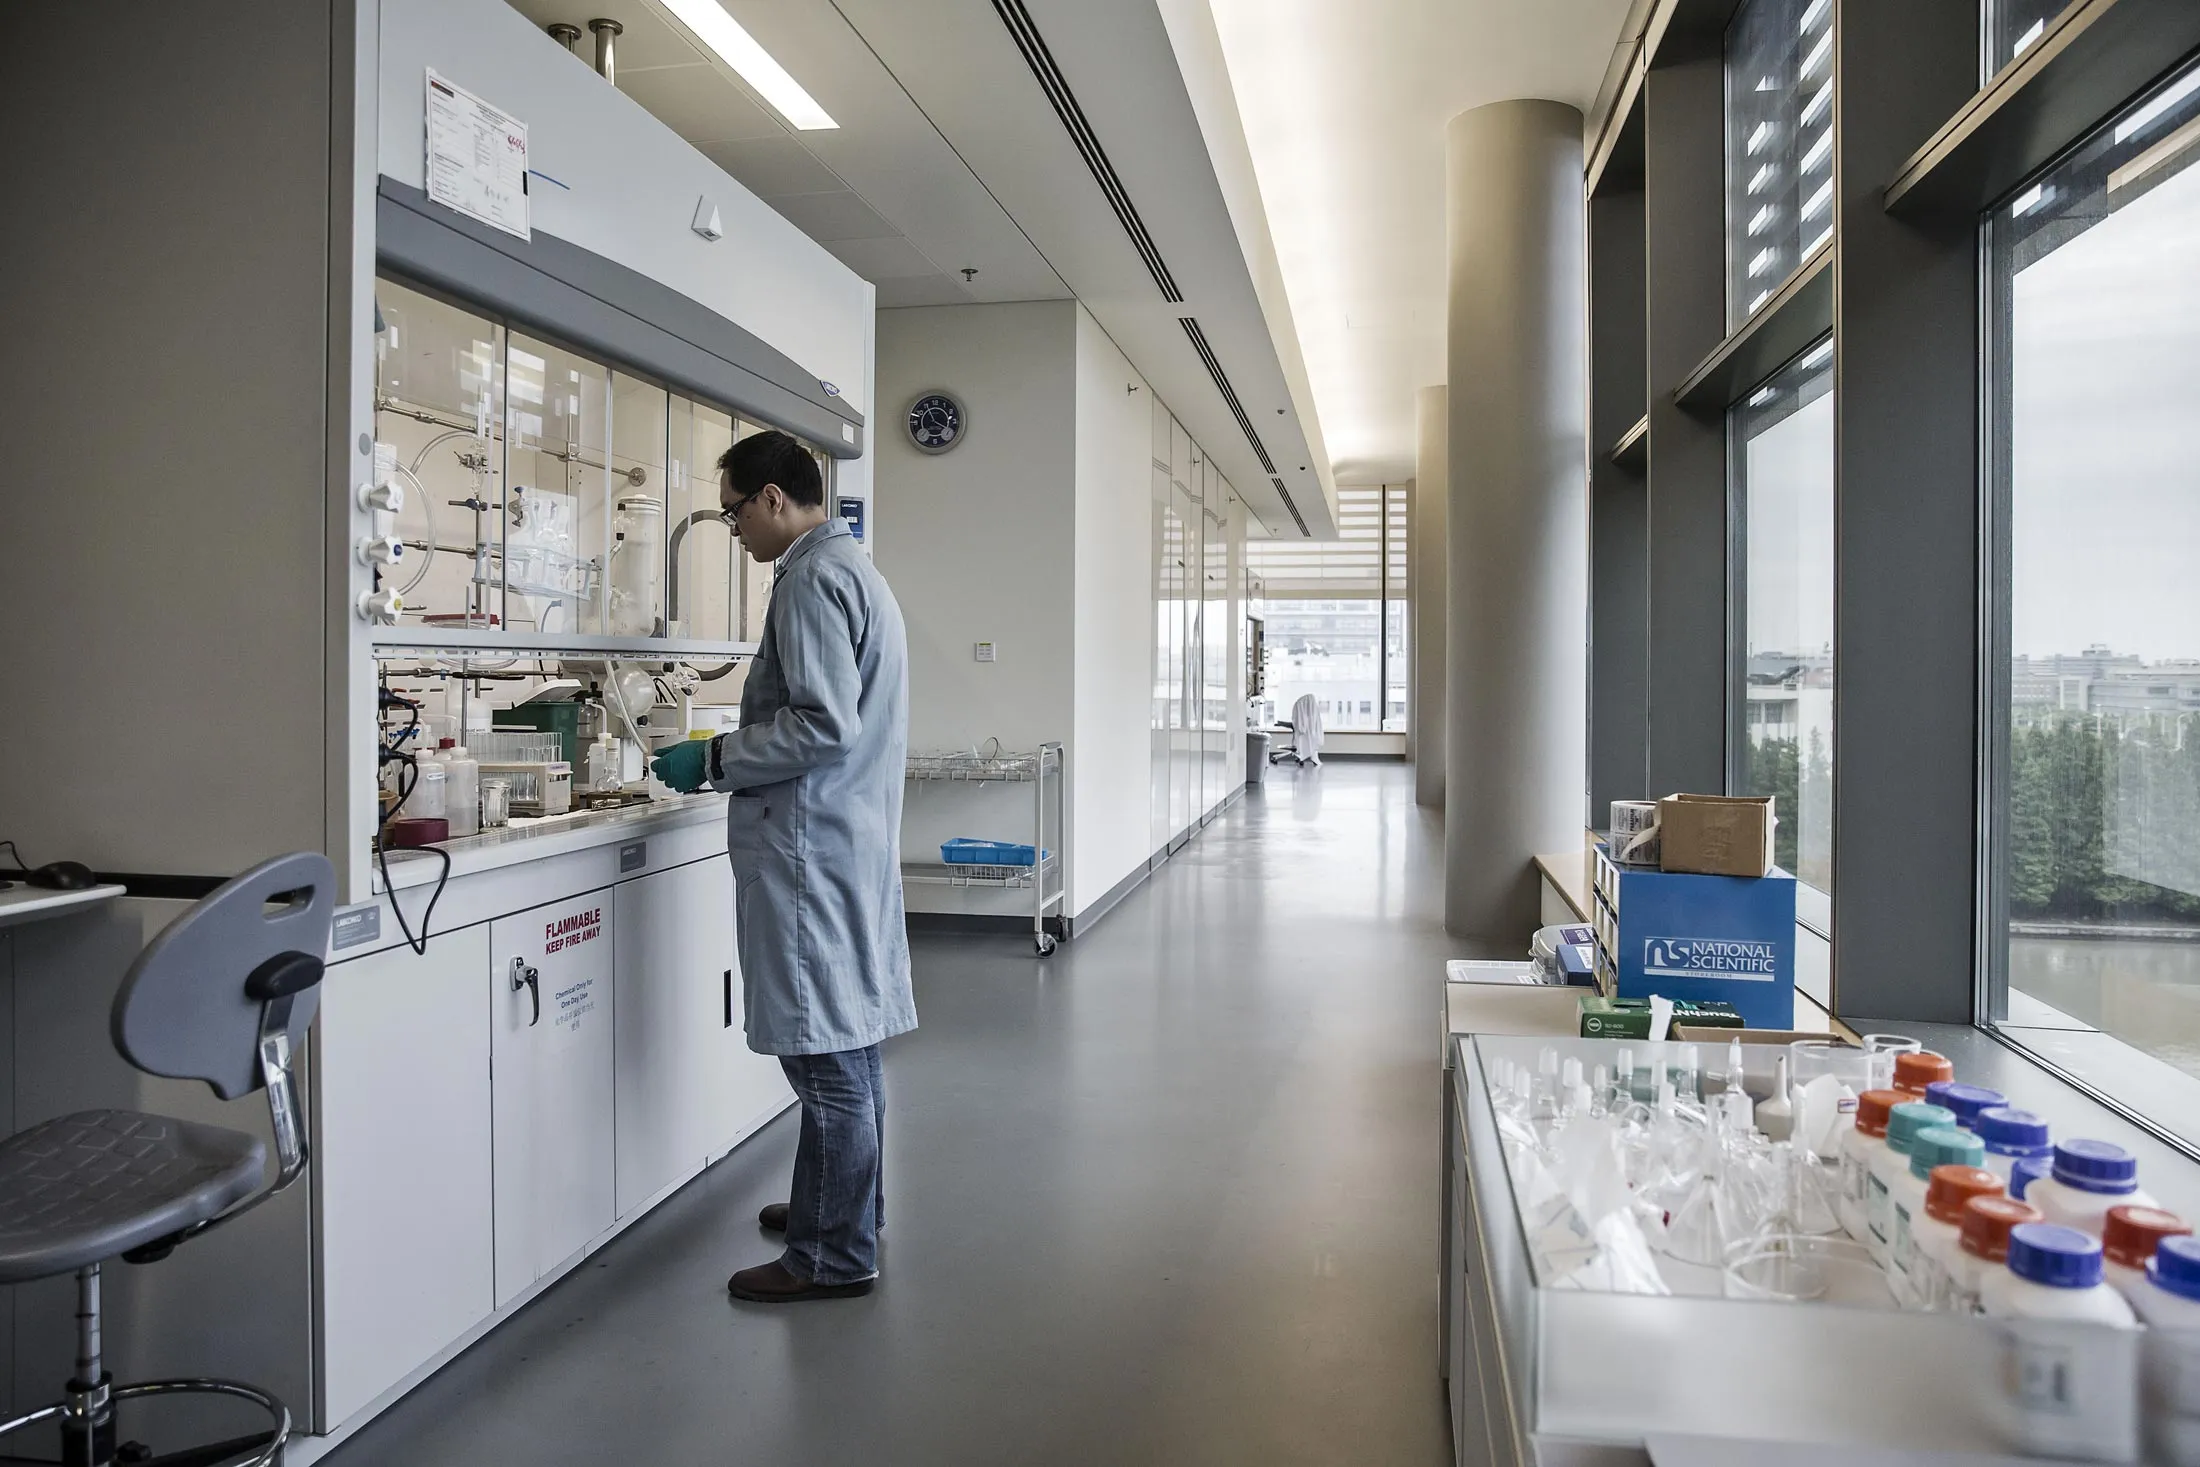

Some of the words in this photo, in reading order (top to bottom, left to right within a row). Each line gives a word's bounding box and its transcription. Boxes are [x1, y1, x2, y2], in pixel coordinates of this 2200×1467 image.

[546, 908, 601, 940] FLAMMABLE
[545, 938, 565, 955] KEEP
[566, 932, 581, 948] FIRE
[582, 925, 601, 942] AWAY
[1692, 942, 1775, 959] NATIONAL
[1690, 955, 1775, 973] SCIENTIFIC
[555, 984, 576, 1000] Chemical
[576, 982, 586, 990] Only
[561, 1000, 570, 1009] One
[571, 996, 579, 1004] Day
[579, 991, 588, 1000] Use
